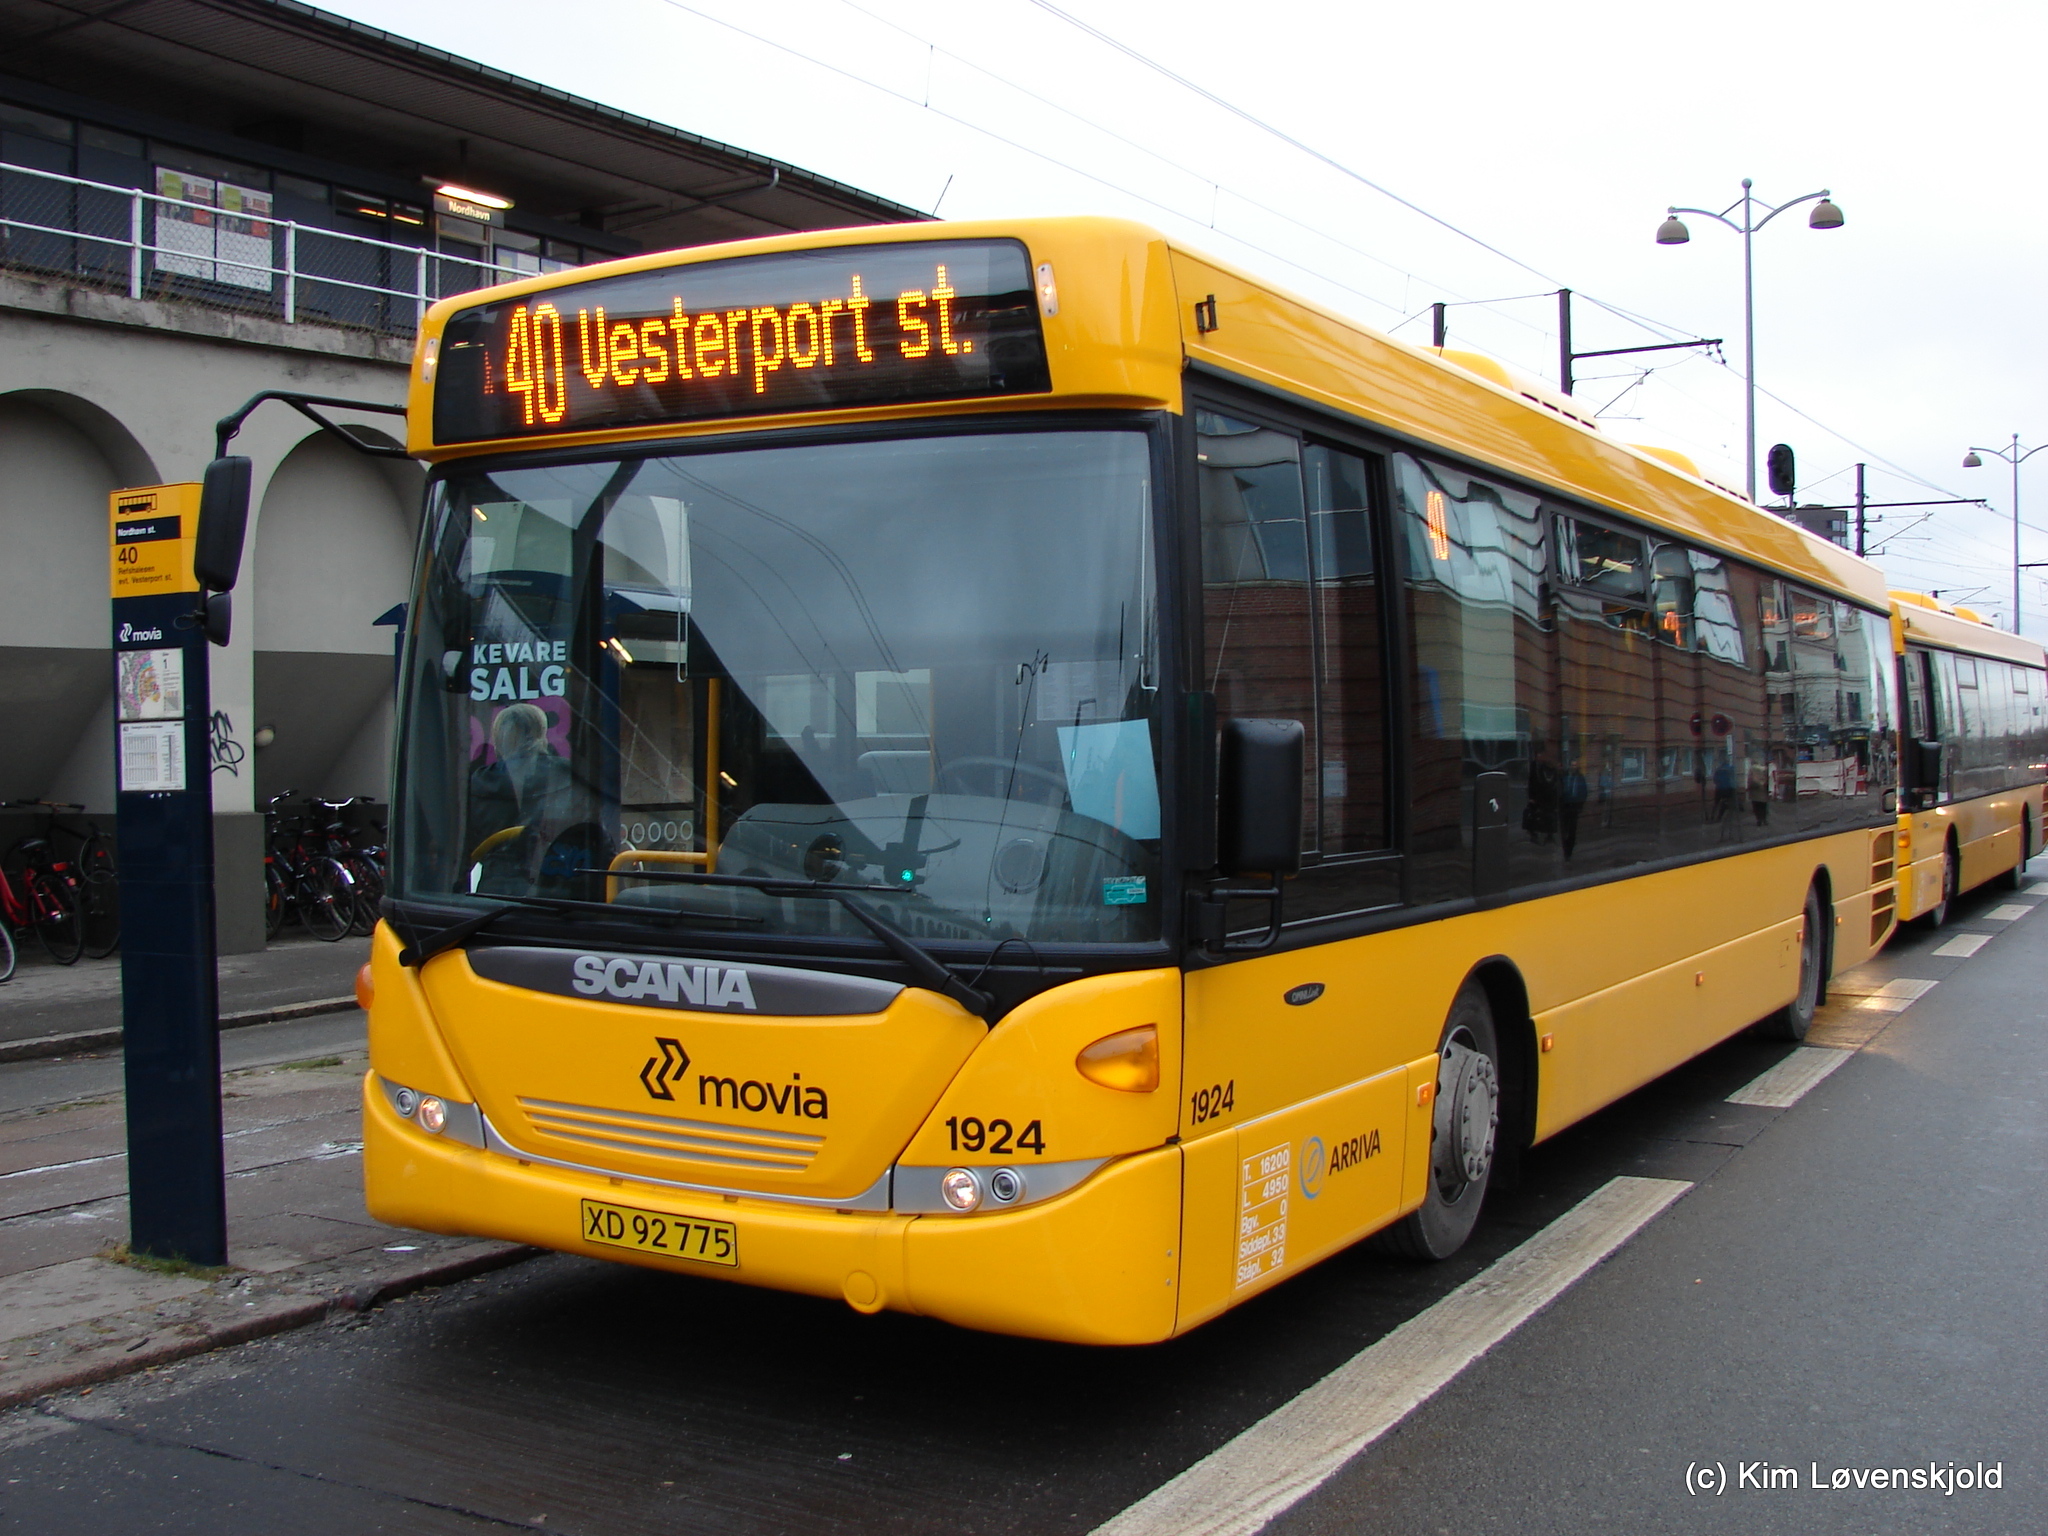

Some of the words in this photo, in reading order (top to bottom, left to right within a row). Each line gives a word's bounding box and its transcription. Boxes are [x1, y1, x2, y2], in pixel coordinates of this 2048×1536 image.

[449, 201, 490, 221] Nordhavn
[507, 303, 566, 425] 40
[579, 275, 873, 394] Vesterport
[898, 265, 972, 359] st.
[117, 527, 147, 537] Nordhavn
[118, 546, 138, 565] 40
[133, 627, 162, 642] movia
[472, 640, 567, 665] KEVARE
[470, 664, 566, 701] SALG
[572, 955, 757, 1010] SCANIA
[698, 1072, 829, 1120] movia
[1191, 1079, 1235, 1126] 1924
[945, 1115, 1046, 1155] 1924
[1260, 1148, 1290, 1175] 16200
[1328, 1128, 1381, 1176] ARRIVA
[1262, 1174, 1288, 1199] 4950
[1280, 1199, 1287, 1216] 0
[588, 1206, 625, 1240] XD
[1272, 1223, 1286, 1243] 33
[1271, 1247, 1285, 1266] 32
